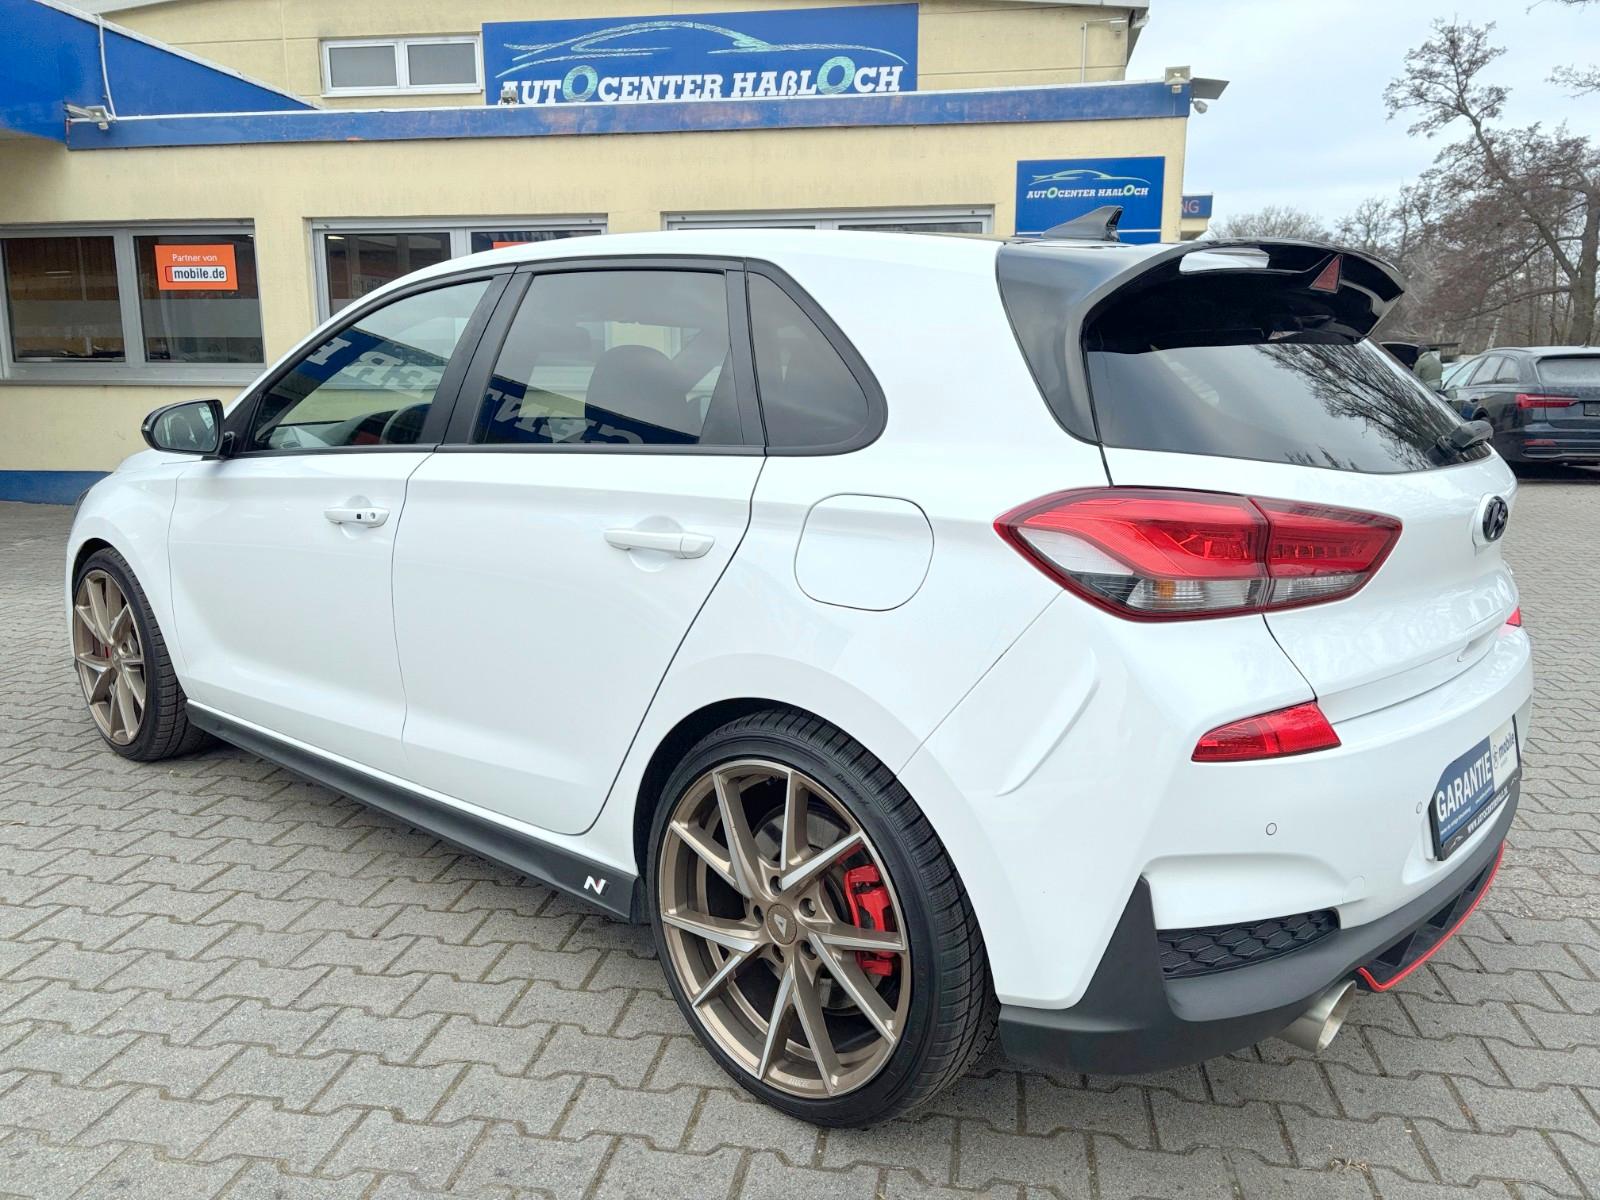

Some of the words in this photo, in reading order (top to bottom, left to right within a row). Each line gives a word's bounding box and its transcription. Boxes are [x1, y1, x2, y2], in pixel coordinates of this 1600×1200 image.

[498, 65, 722, 104] AUTOCENTER
[732, 57, 903, 97] HAßLOCH
[1026, 187, 1096, 199] AUTOCENTER
[172, 253, 201, 262] Partner
[202, 254, 218, 262] von
[174, 268, 225, 279] mobile.de
[1437, 751, 1492, 822] GARANTIE
[583, 875, 607, 896] N
